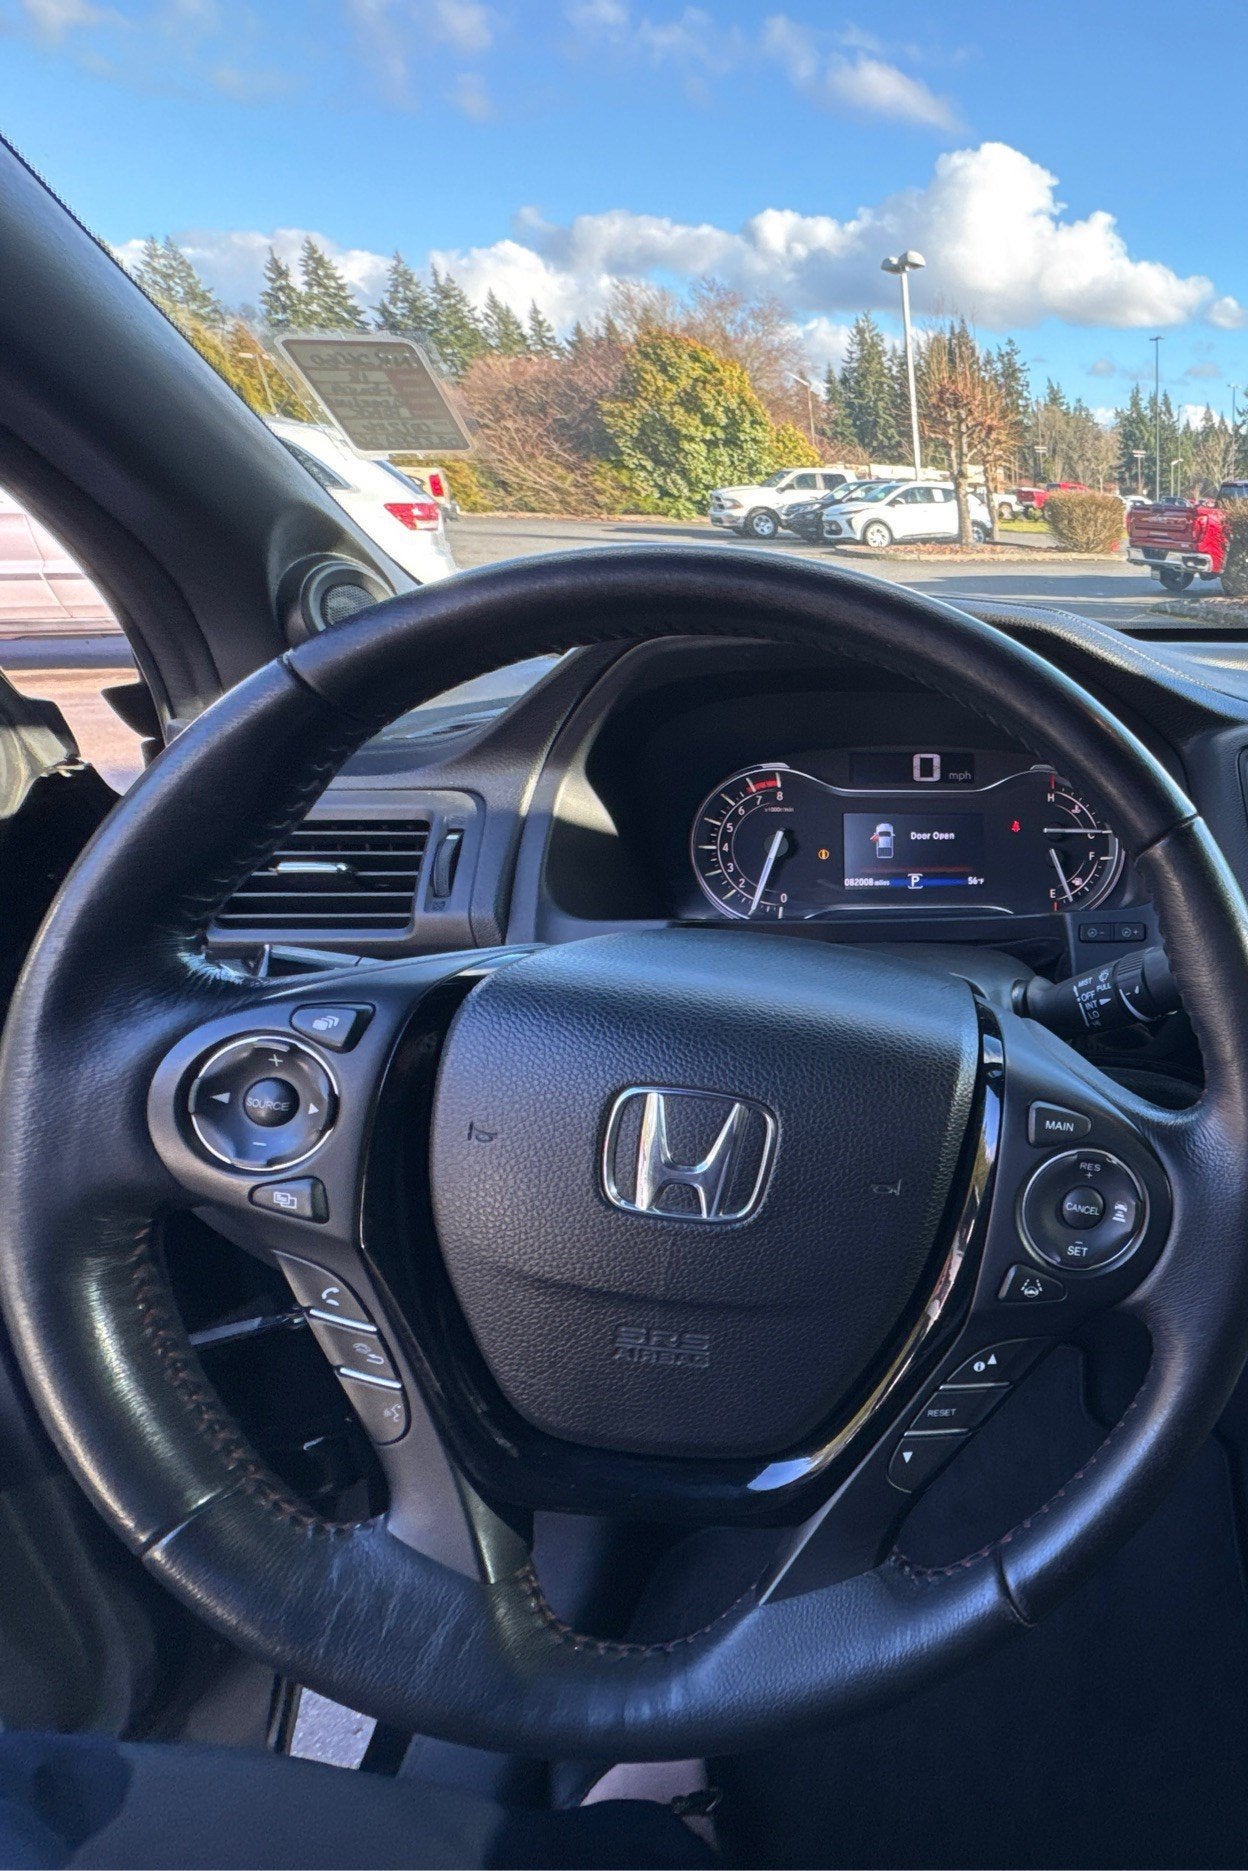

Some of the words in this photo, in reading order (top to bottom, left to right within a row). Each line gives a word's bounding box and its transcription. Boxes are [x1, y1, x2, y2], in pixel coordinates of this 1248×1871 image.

[912, 753, 941, 782] 0
[948, 770, 972, 782] mph
[756, 796, 762, 805] 7
[776, 791, 784, 801] 8
[1047, 793, 1055, 802] H
[738, 806, 745, 815] 6
[726, 822, 733, 832] 5
[910, 831, 931, 840] Door
[932, 831, 955, 841] Open
[722, 842, 729, 852] 4
[1089, 851, 1095, 861] F
[727, 862, 734, 872] 3
[738, 878, 746, 888] 2
[844, 878, 874, 886] 082008
[911, 876, 920, 887] P
[780, 893, 788, 903] 0
[1049, 889, 1056, 898] E
[1096, 983, 1112, 992] PULL
[1081, 990, 1096, 1002] OFF
[1085, 1000, 1098, 1010] INT
[1087, 1010, 1100, 1020] LO
[246, 1097, 290, 1112] SOURCE
[1044, 1119, 1075, 1132] MAIN
[1079, 1161, 1101, 1172] RES
[1065, 1202, 1100, 1216] CANCEL
[1067, 1245, 1088, 1258] SET
[926, 1408, 957, 1418] RESET
